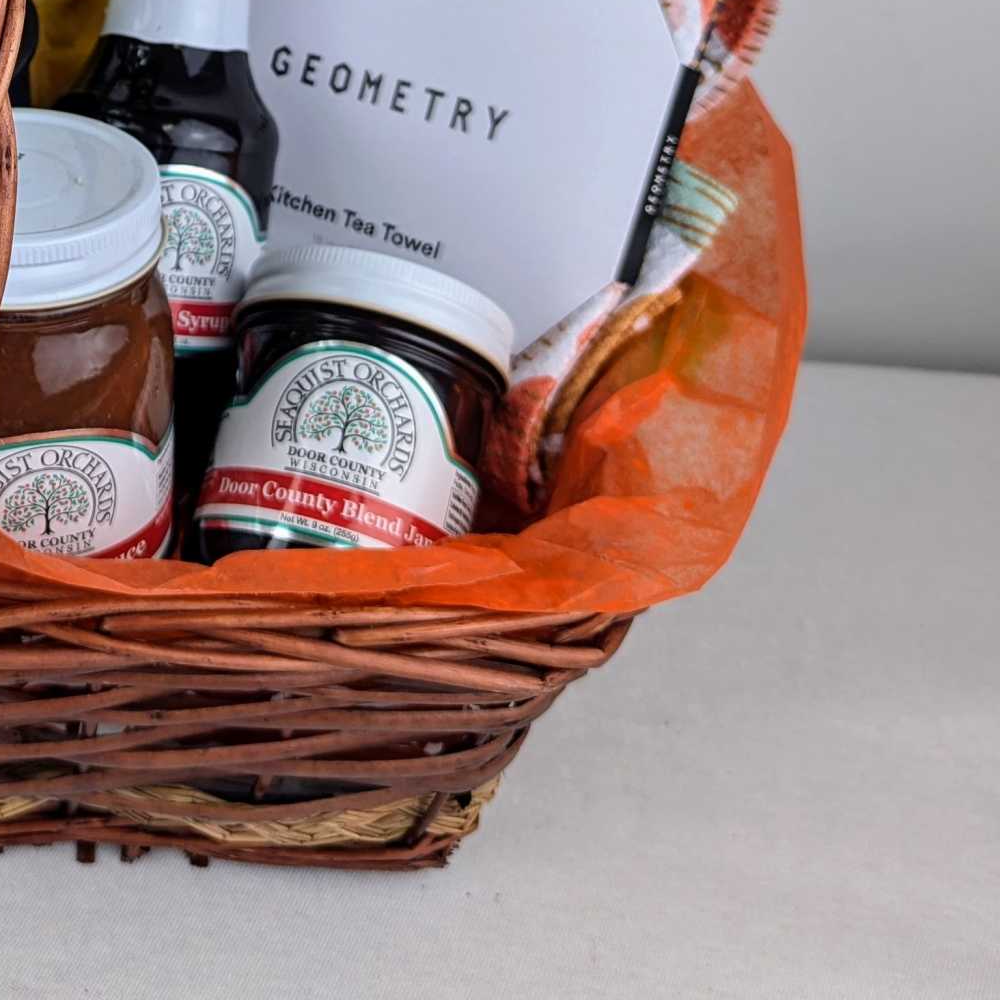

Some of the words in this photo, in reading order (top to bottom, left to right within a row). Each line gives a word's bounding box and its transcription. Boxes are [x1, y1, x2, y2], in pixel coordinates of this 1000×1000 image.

[271, 45, 510, 141] GEOMETRY
[644, 135, 677, 214] GEOMETRY
[181, 184, 232, 280] ORCHARDS
[343, 209, 375, 237] Tea
[382, 222, 441, 258] Towel
[169, 273, 216, 286] COUNTY
[275, 359, 347, 442] SEAQUIST
[353, 362, 413, 475] ORCHARDS
[41, 448, 113, 525] ORCHARDS
[288, 445, 326, 462] DOOR
[330, 455, 386, 480] COUNTY
[290, 457, 378, 489] WISCONSIN
[218, 476, 260, 495] Door
[262, 480, 338, 514] County
[342, 500, 401, 536] Blend
[280, 513, 295, 522] Net
[311, 520, 318, 529] 9
[40, 528, 96, 548] COUNTY
